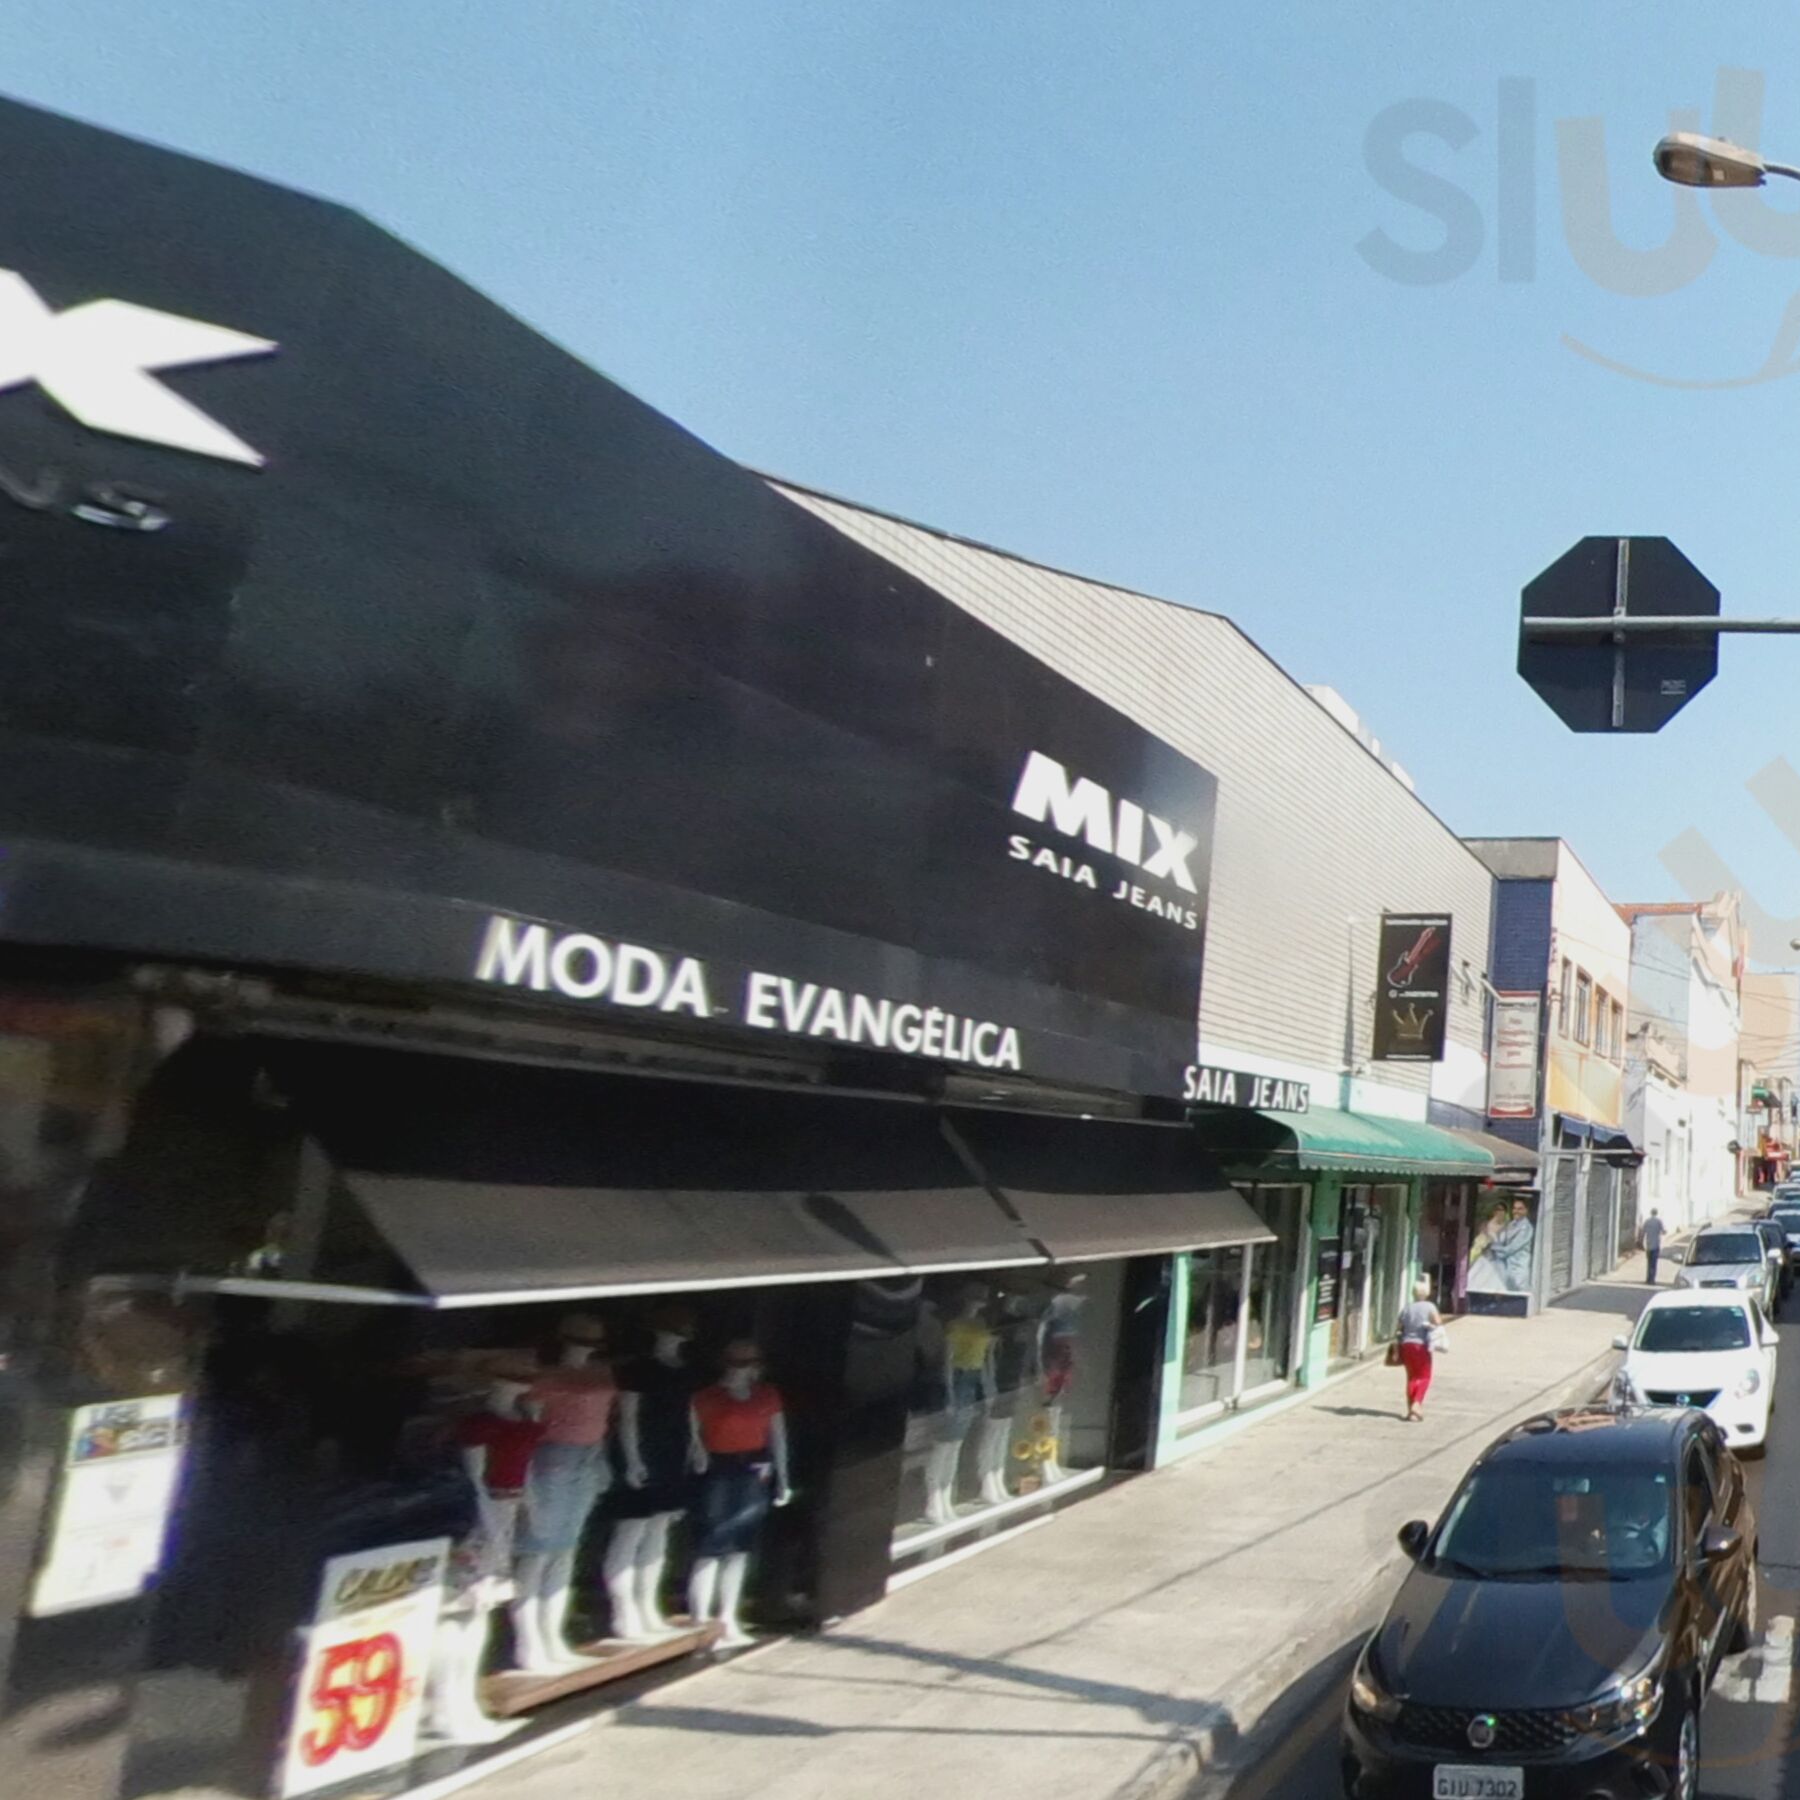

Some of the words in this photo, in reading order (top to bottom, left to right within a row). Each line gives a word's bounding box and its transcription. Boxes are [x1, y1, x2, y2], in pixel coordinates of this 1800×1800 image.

[1012, 750, 1198, 895] MIX
[1007, 835, 1098, 890] SAIA
[1112, 880, 1199, 931] JEANS
[474, 915, 711, 1018] MODA
[745, 972, 1023, 1071] EVANGÉLICA
[1183, 1065, 1236, 1105] SAIA
[1248, 1077, 1309, 1113] JEANS
[299, 1631, 403, 1768] 59
[1475, 1779, 1517, 1798] 7302
